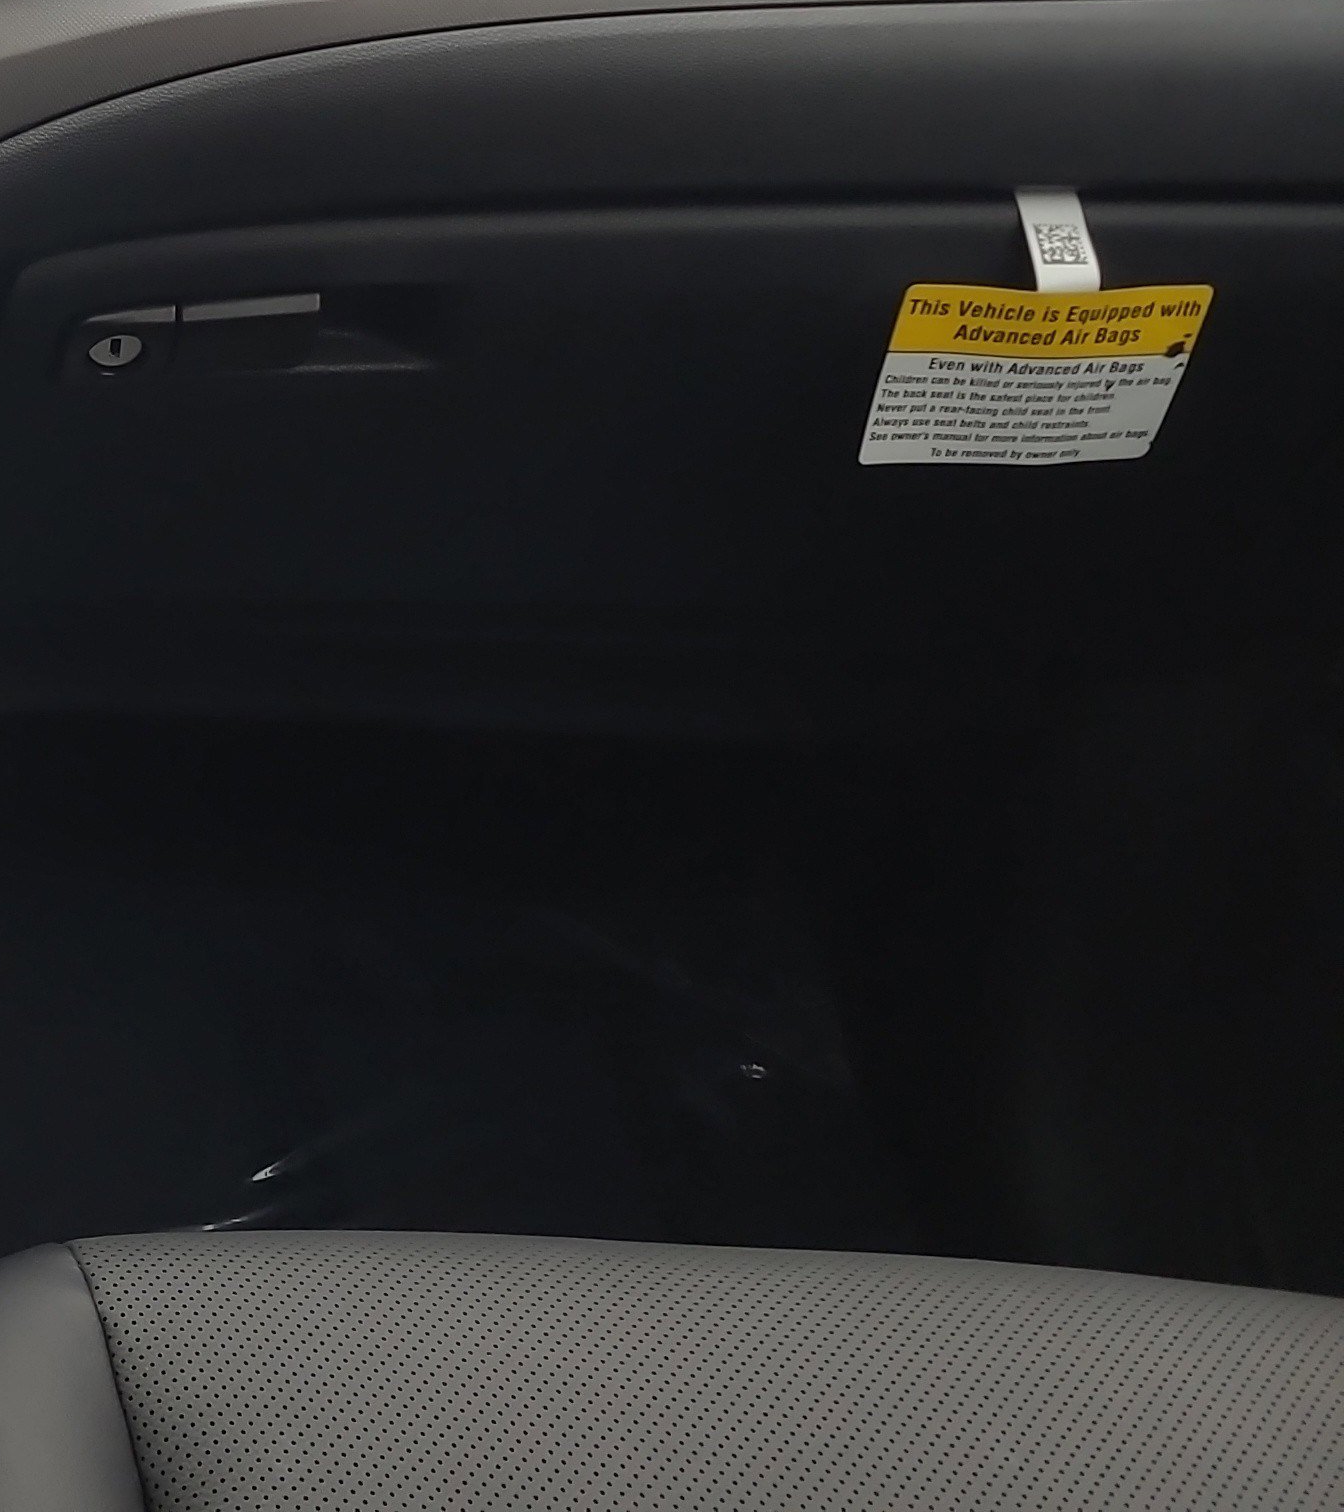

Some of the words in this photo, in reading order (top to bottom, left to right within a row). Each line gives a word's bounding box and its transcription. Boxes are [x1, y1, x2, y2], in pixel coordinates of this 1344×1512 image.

[909, 298, 951, 316] This
[959, 300, 1035, 322] Vehicle
[1042, 306, 1060, 322] is
[1066, 301, 1155, 324] Equipped
[1161, 300, 1201, 317] with
[953, 324, 1057, 345] Advanced
[1060, 329, 1089, 345] Air
[1095, 327, 1141, 346] Bags
[928, 358, 964, 371] Even
[970, 360, 1003, 373] with
[1007, 362, 1080, 375] Advanced
[1084, 361, 1105, 373] Air
[1110, 361, 1144, 374] Bags
[885, 374, 928, 385] Children
[931, 376, 950, 384] can
[953, 377, 966, 386] be
[969, 378, 1000, 387] killed
[1118, 378, 1133, 386] the
[881, 389, 899, 398] The
[903, 389, 927, 398] back
[930, 390, 954, 399] seat
[957, 391, 966, 400] is
[969, 392, 986, 401] the
[1024, 395, 1053, 404] place
[1056, 394, 1071, 402] for
[877, 403, 907, 412] Never
[910, 404, 927, 413] put
[939, 405, 999, 416] rear-facing
[1002, 407, 1028, 416] child
[1031, 408, 1053, 416] seat
[872, 418, 909, 427] Always
[933, 419, 957, 427] seat
[959, 419, 986, 428] belts
[989, 421, 1009, 429] and
[1012, 421, 1038, 429] child
[869, 432, 888, 441] See
[891, 432, 929, 441] owner's
[932, 432, 972, 442] manual
[974, 433, 989, 442] for
[991, 434, 1018, 442] more
[931, 447, 942, 457] To
[945, 448, 958, 457] be
[961, 449, 1008, 458] removed
[1010, 450, 1023, 460] by
[1025, 451, 1057, 459] owner
